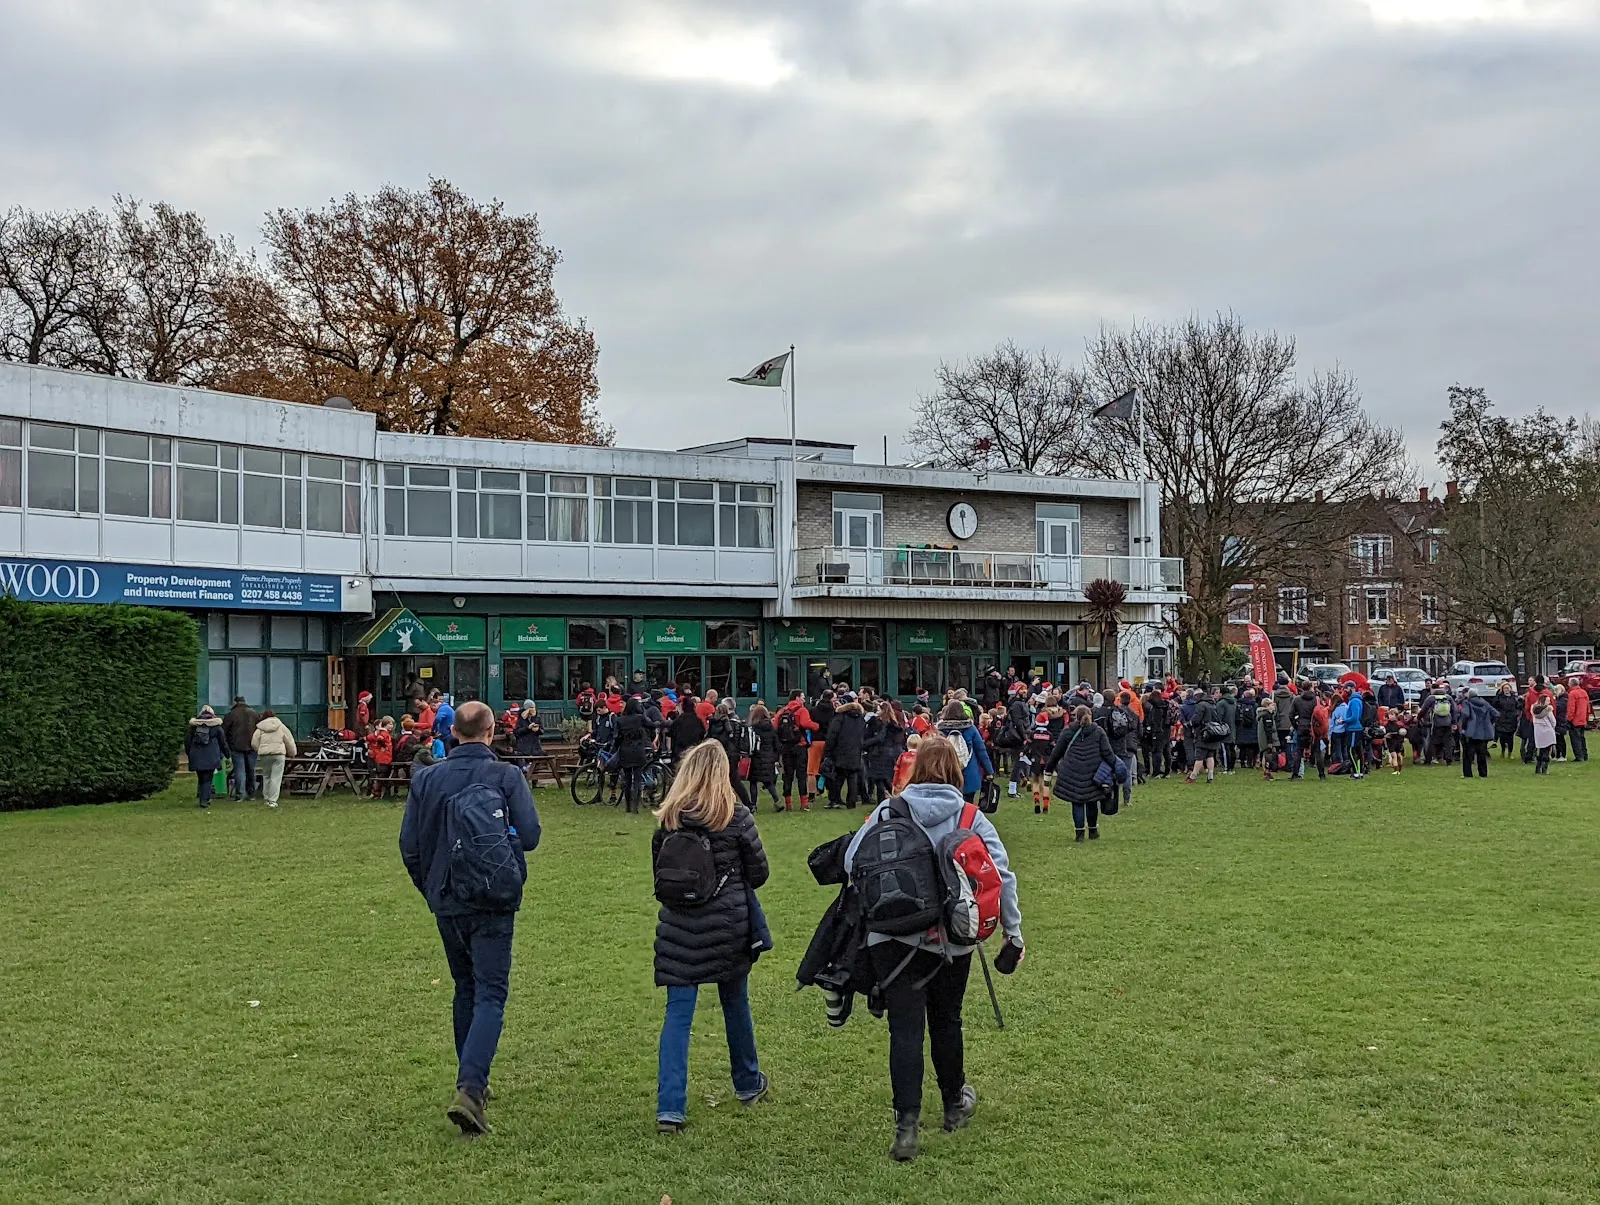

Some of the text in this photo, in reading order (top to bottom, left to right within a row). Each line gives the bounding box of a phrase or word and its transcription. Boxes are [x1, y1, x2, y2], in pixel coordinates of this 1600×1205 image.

[126, 573, 231, 588] Property Development
[123, 587, 234, 600] and Investment Finance
[241, 589, 303, 600] 0207 458 4436
[656, 635, 685, 643] Heineken
